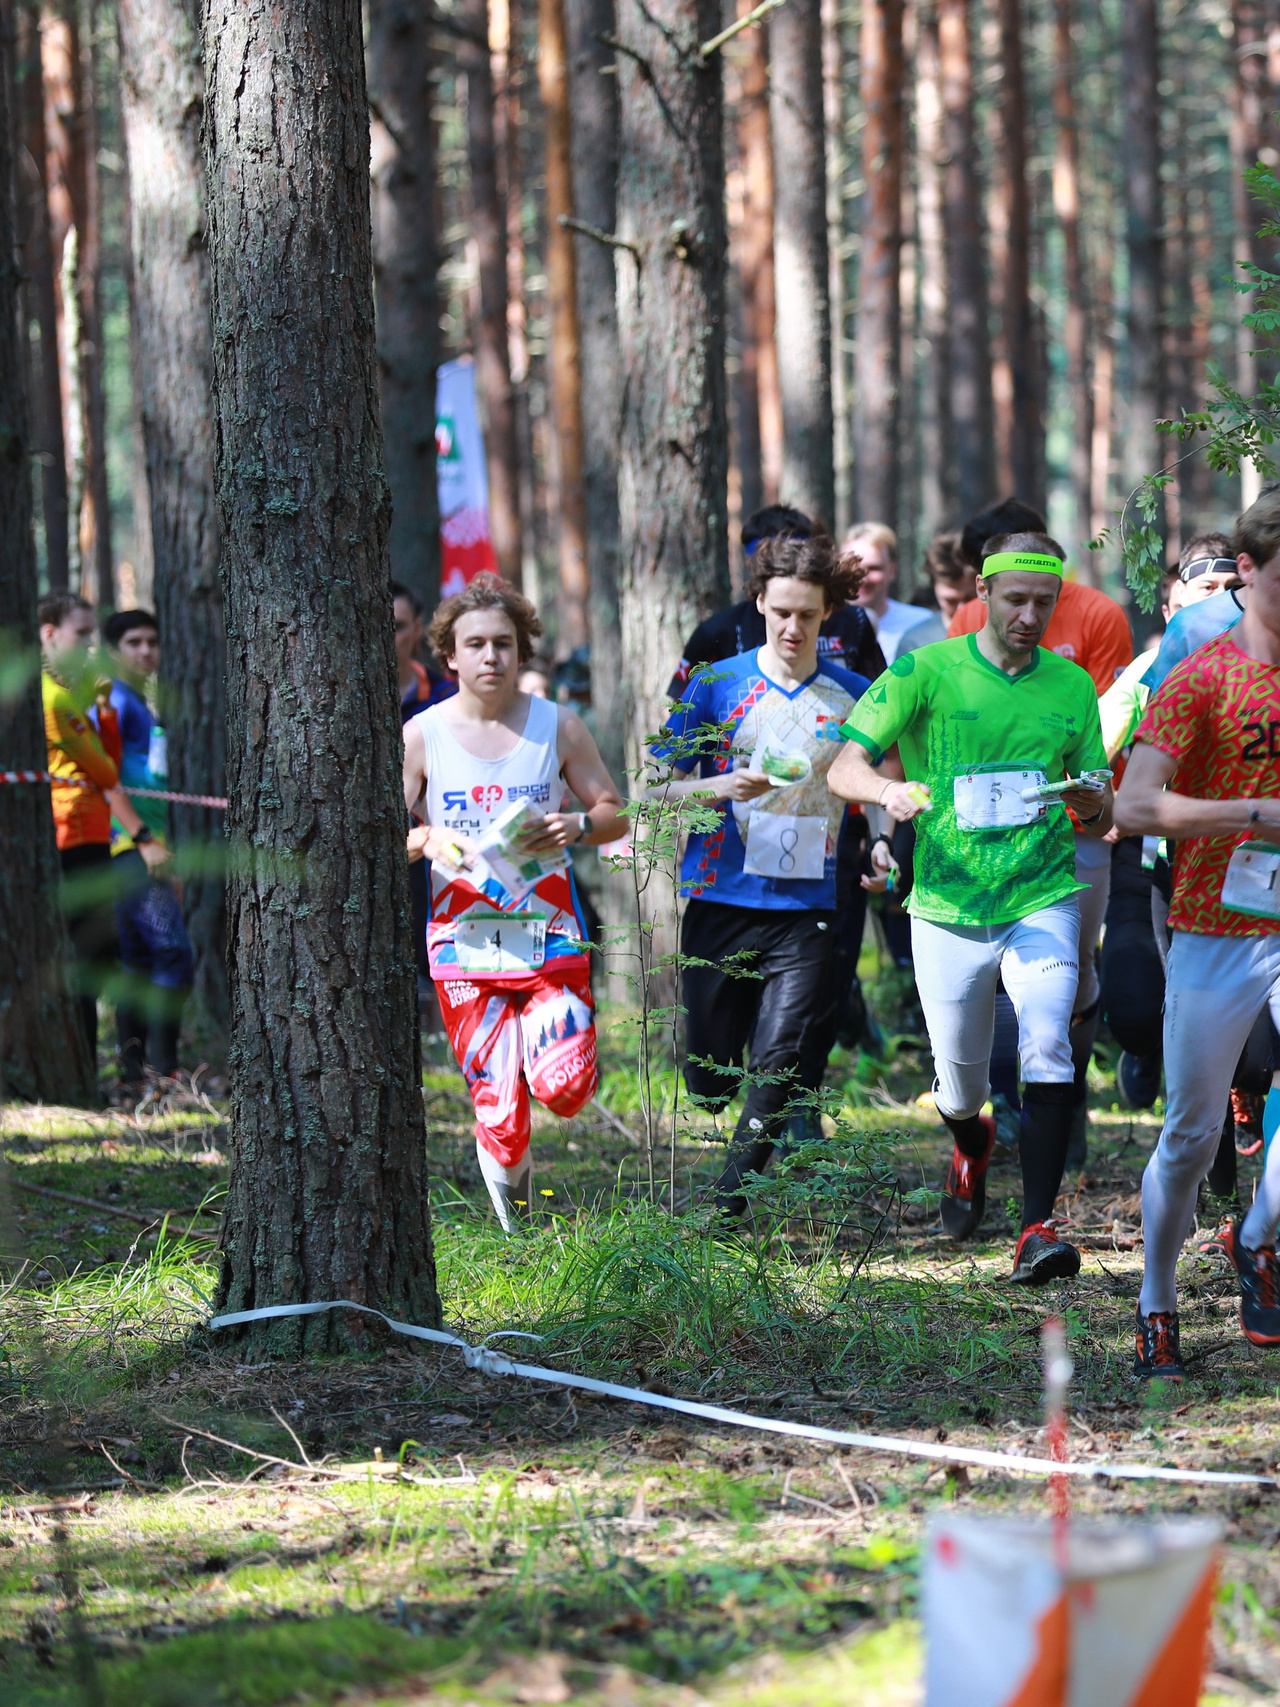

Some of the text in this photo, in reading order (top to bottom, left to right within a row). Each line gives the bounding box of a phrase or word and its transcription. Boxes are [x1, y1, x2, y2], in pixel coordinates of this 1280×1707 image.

[1014, 557, 1057, 568] noname
[507, 781, 551, 794] SOCHI
[990, 781, 1003, 803] 5
[442, 790, 467, 811] Я
[778, 828, 800, 873] 8
[1265, 868, 1278, 891] 1
[490, 929, 502, 948] 4
[546, 1041, 597, 1095] РОДОНИ
